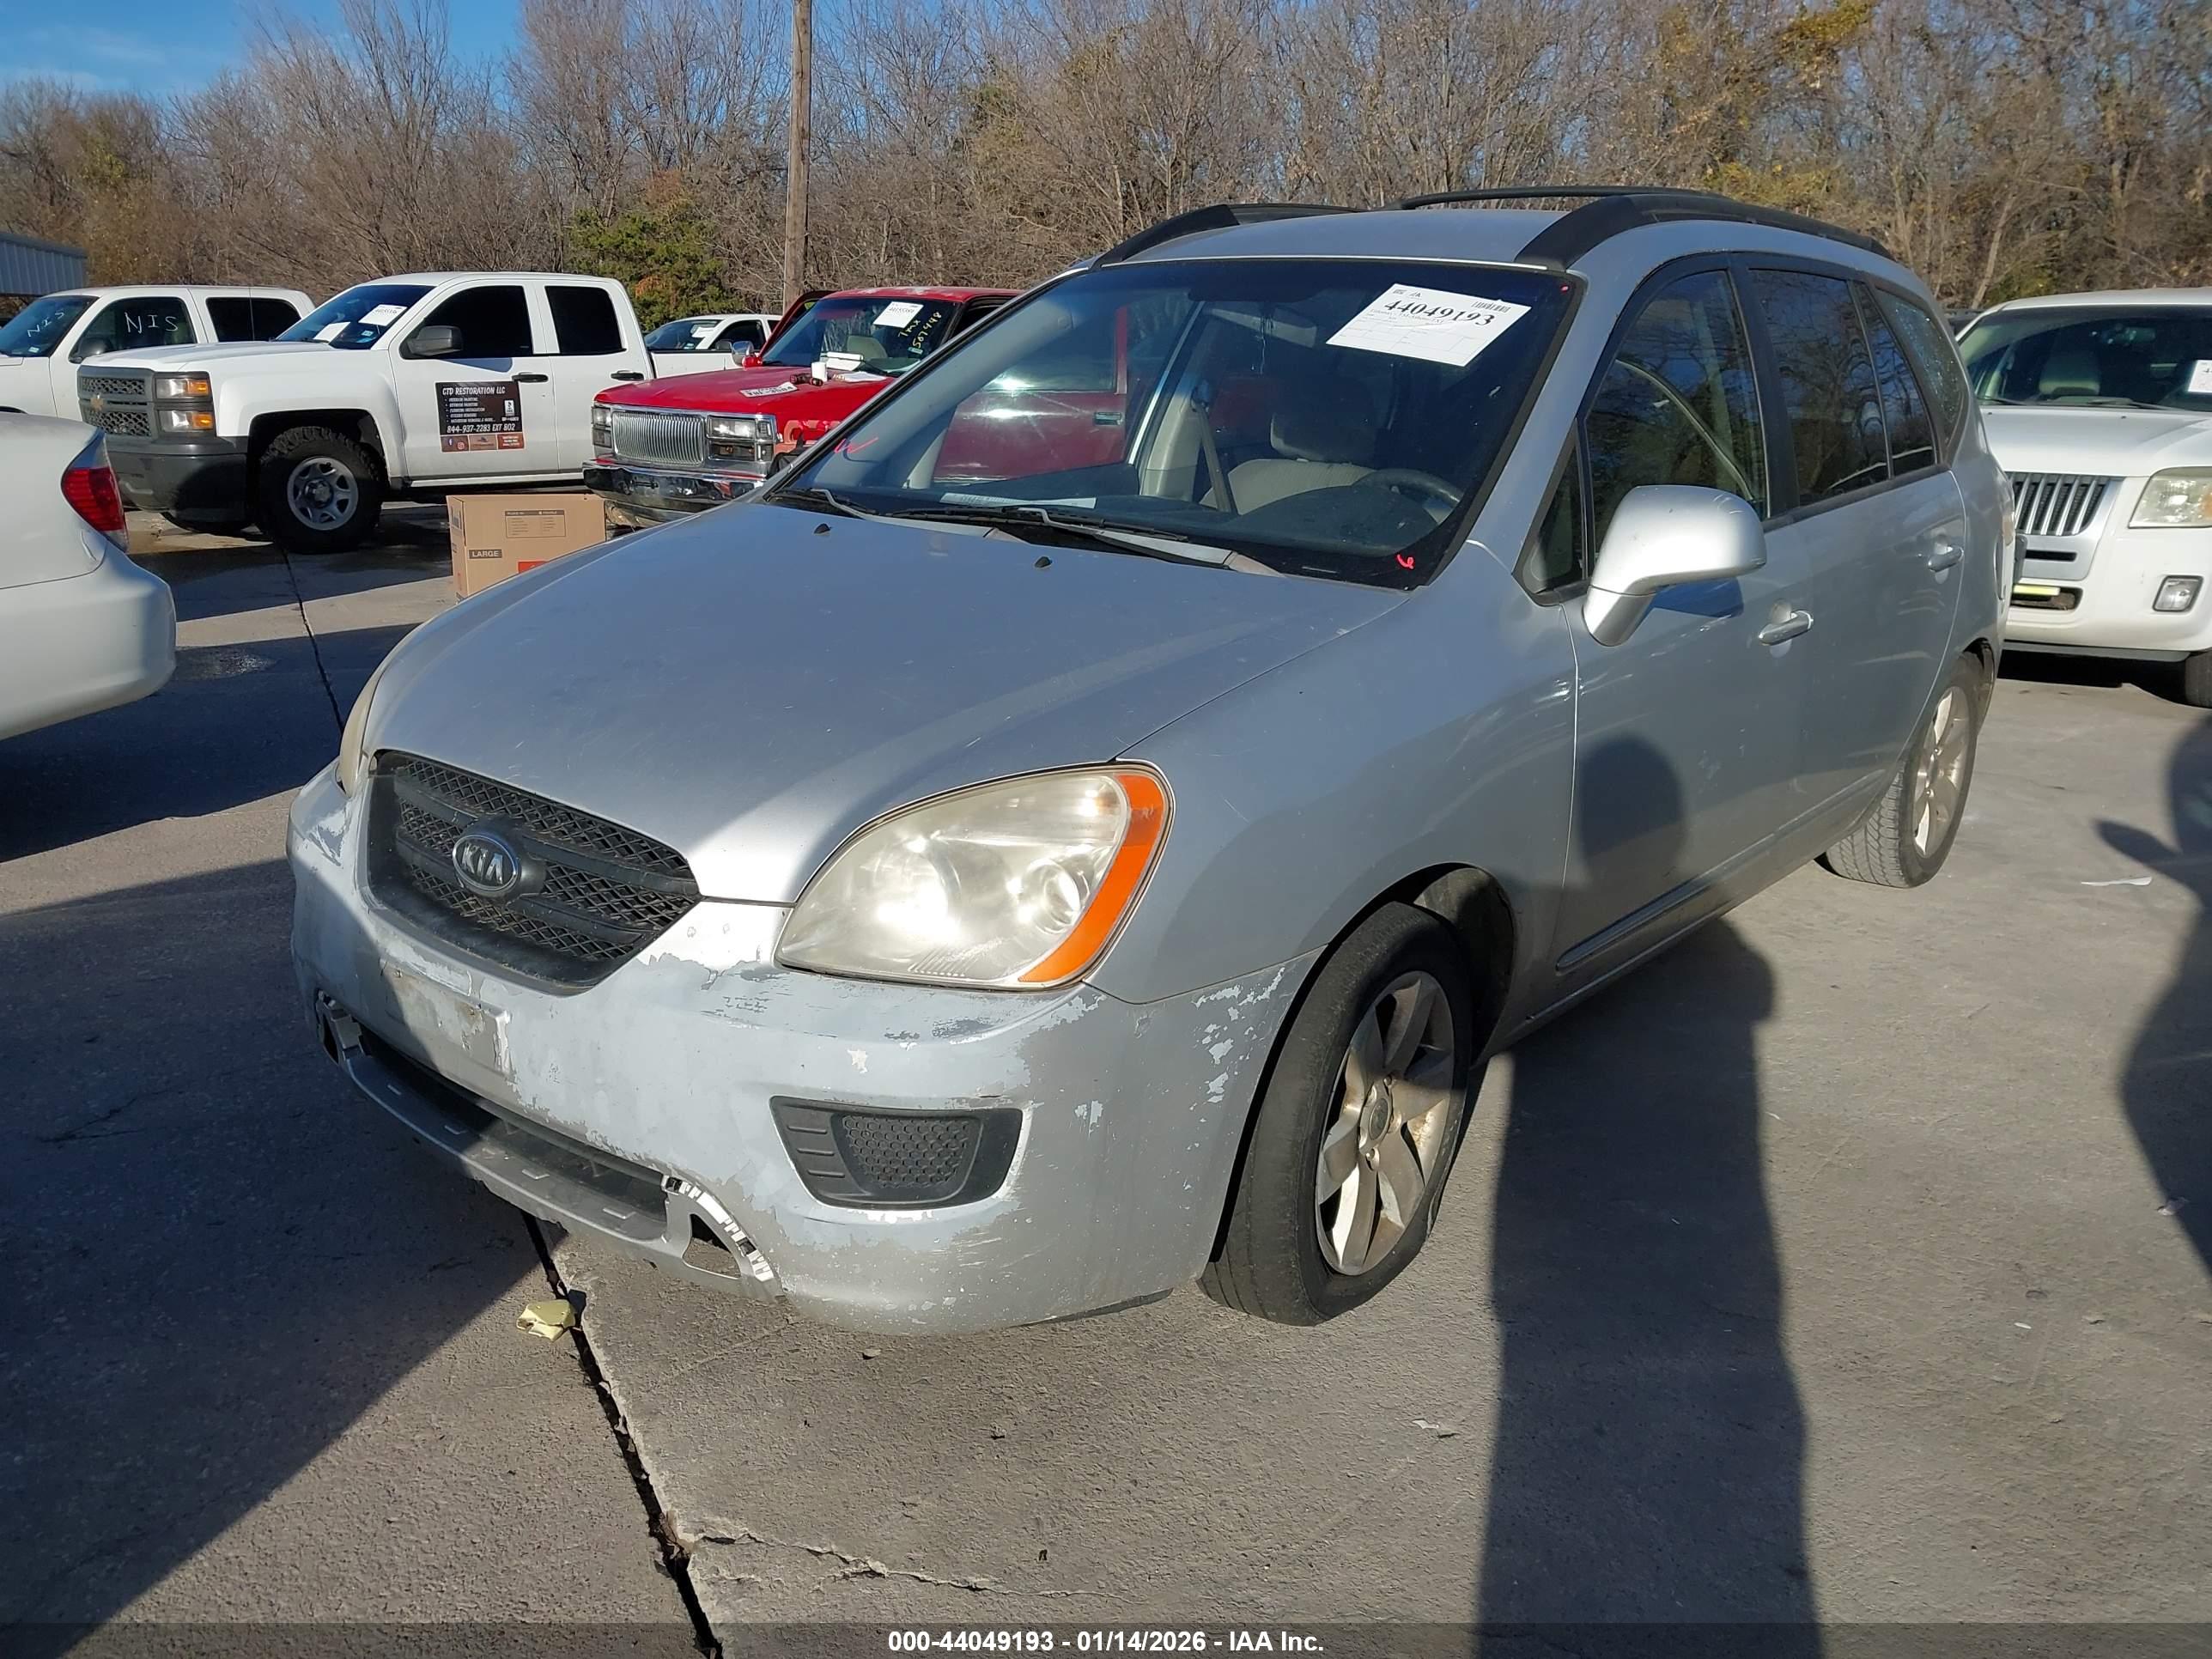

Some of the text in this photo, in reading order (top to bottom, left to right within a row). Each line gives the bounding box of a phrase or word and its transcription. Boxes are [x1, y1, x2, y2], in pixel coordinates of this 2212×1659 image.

[27, 308, 65, 337] NIS
[124, 311, 179, 334] NIS
[1383, 300, 1496, 326] 44049193
[455, 386, 495, 396] RESTORATION
[495, 386, 506, 395] LLC
[491, 423, 503, 432] EXT
[461, 842, 503, 885] KIA
